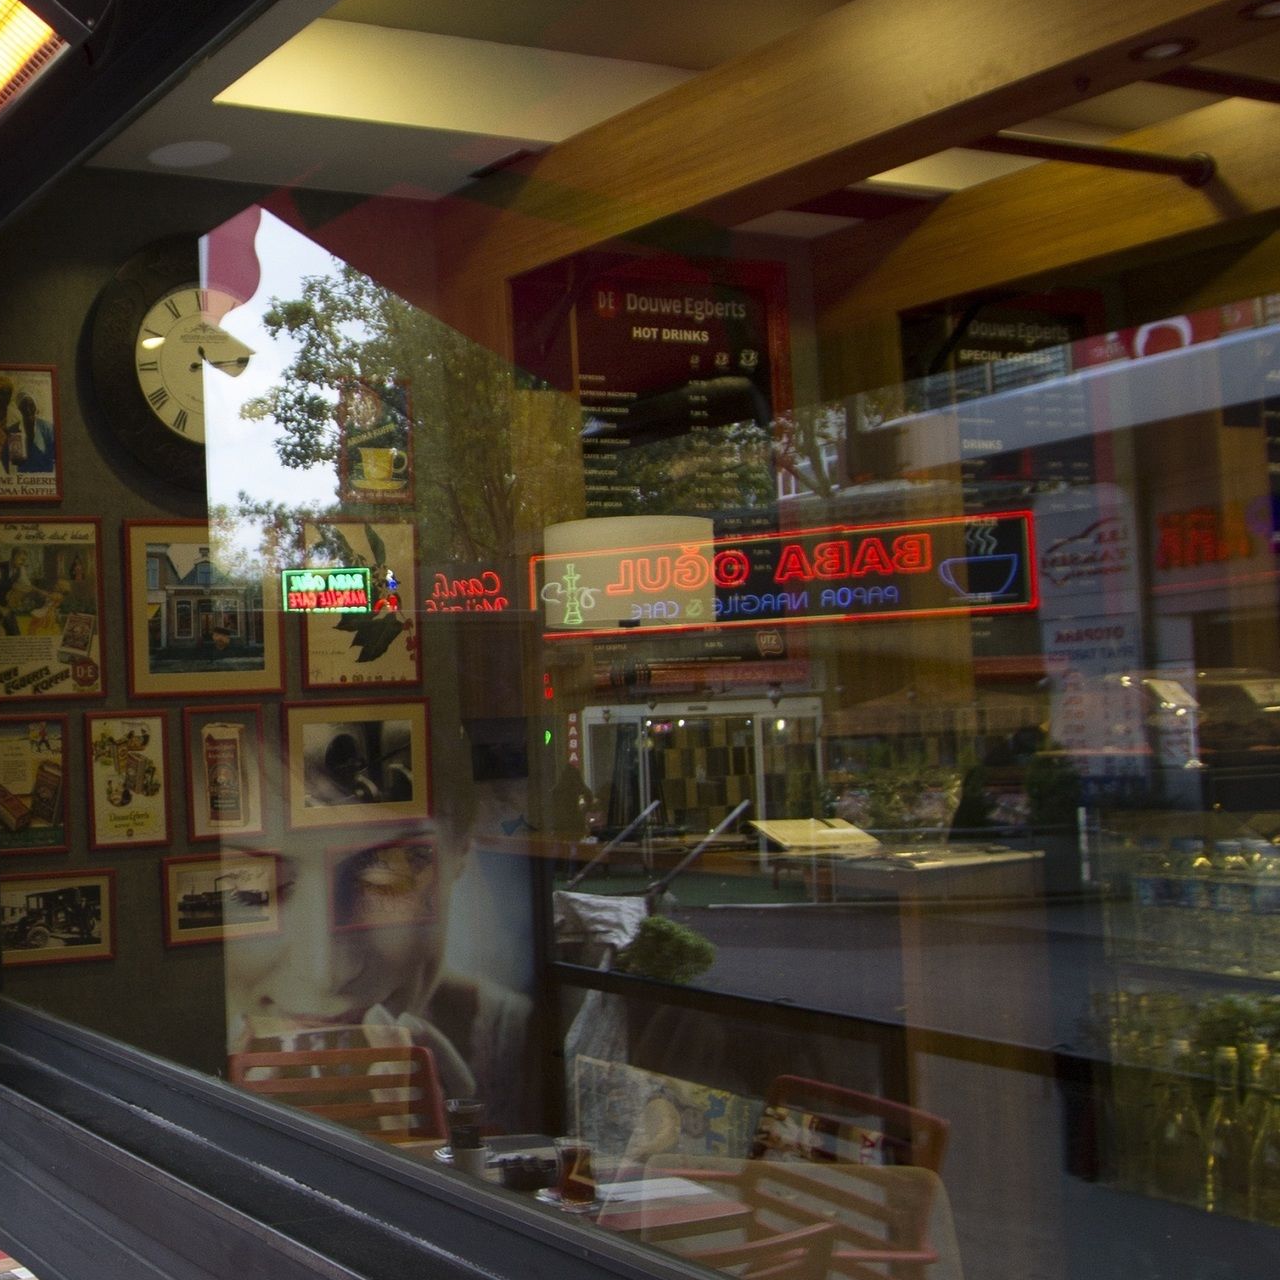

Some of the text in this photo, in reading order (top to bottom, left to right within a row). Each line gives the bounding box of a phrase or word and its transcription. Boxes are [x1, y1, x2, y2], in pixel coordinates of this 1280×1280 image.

[626, 293, 682, 314] Douwe
[684, 297, 747, 323] Egberts
[632, 326, 709, 343] HOT DRINKS
[959, 349, 1004, 361] SPECIAL
[962, 438, 1003, 450] DRINKS
[760, 634, 777, 645] UTZ
